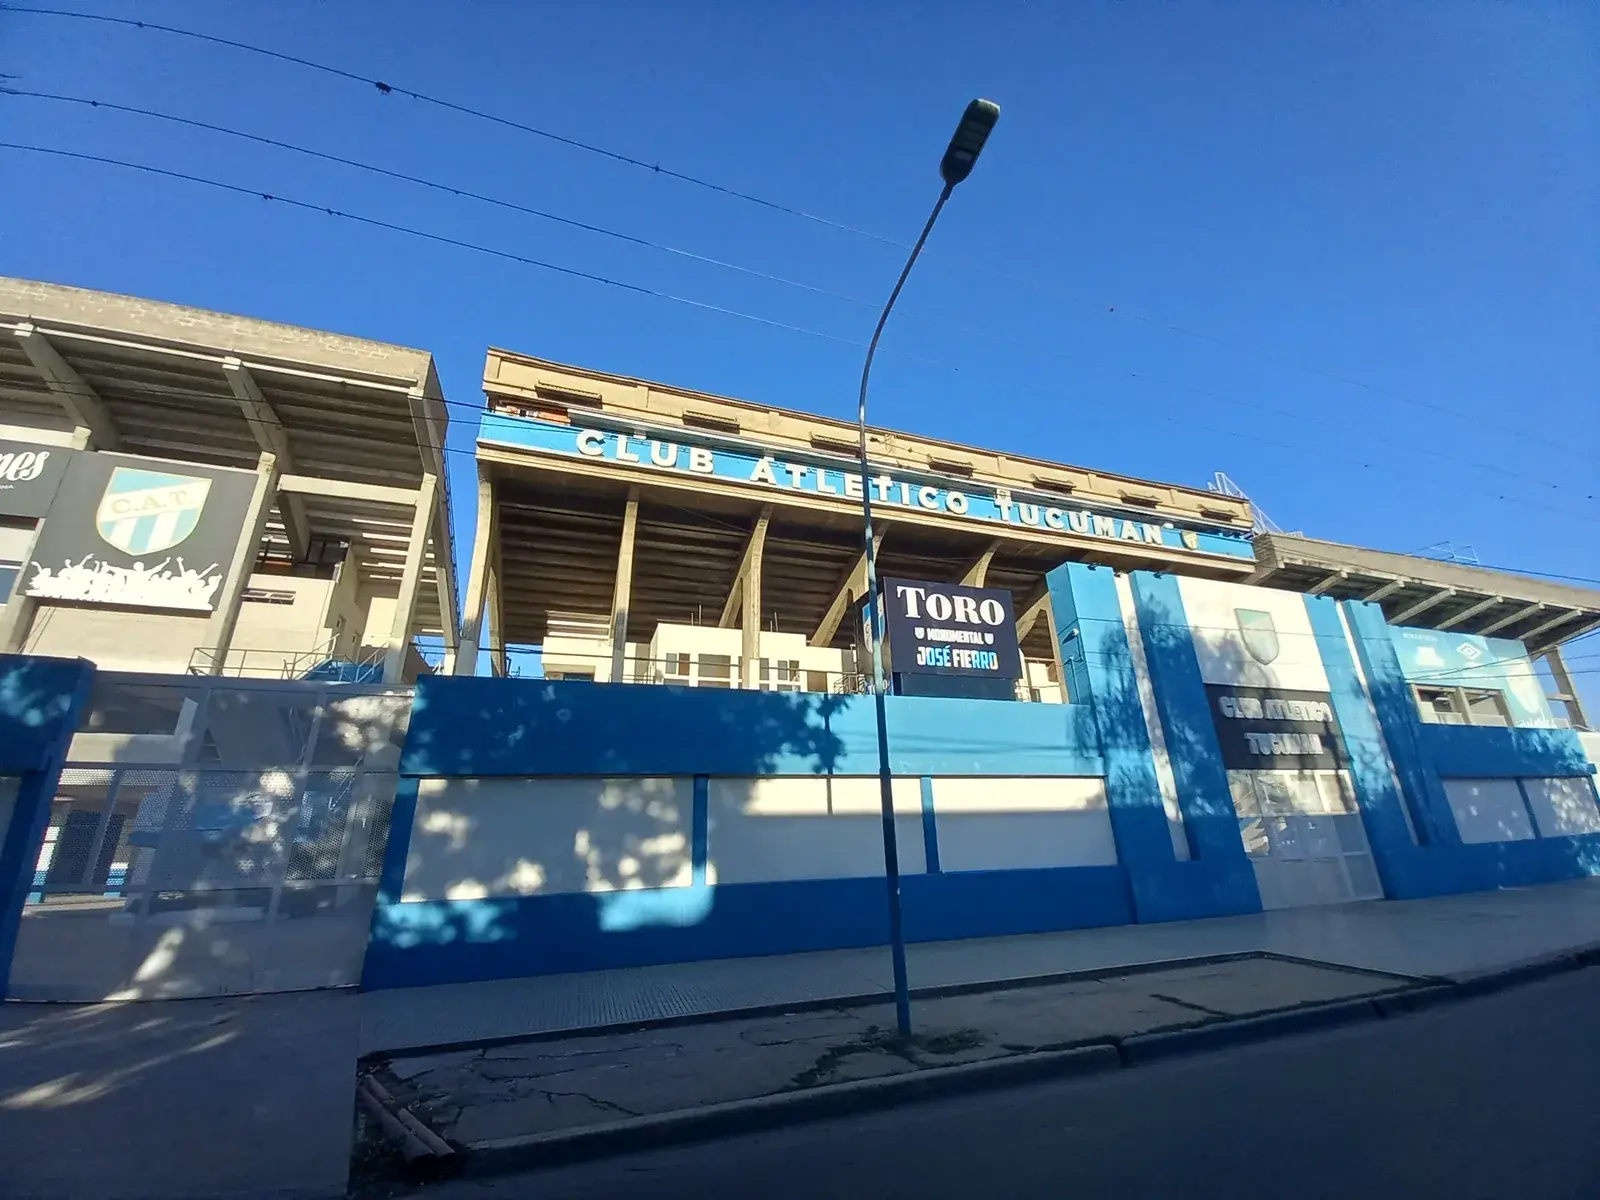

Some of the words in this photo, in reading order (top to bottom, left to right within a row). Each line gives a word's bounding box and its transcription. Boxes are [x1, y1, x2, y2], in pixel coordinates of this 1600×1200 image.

[576, 429, 714, 473] CLUB
[749, 456, 969, 515] ATLETICO
[897, 586, 1006, 626] TORO
[926, 627, 985, 645] MONUMENTAL
[917, 645, 952, 667] JOSÉ
[952, 648, 999, 670] FIERRO
